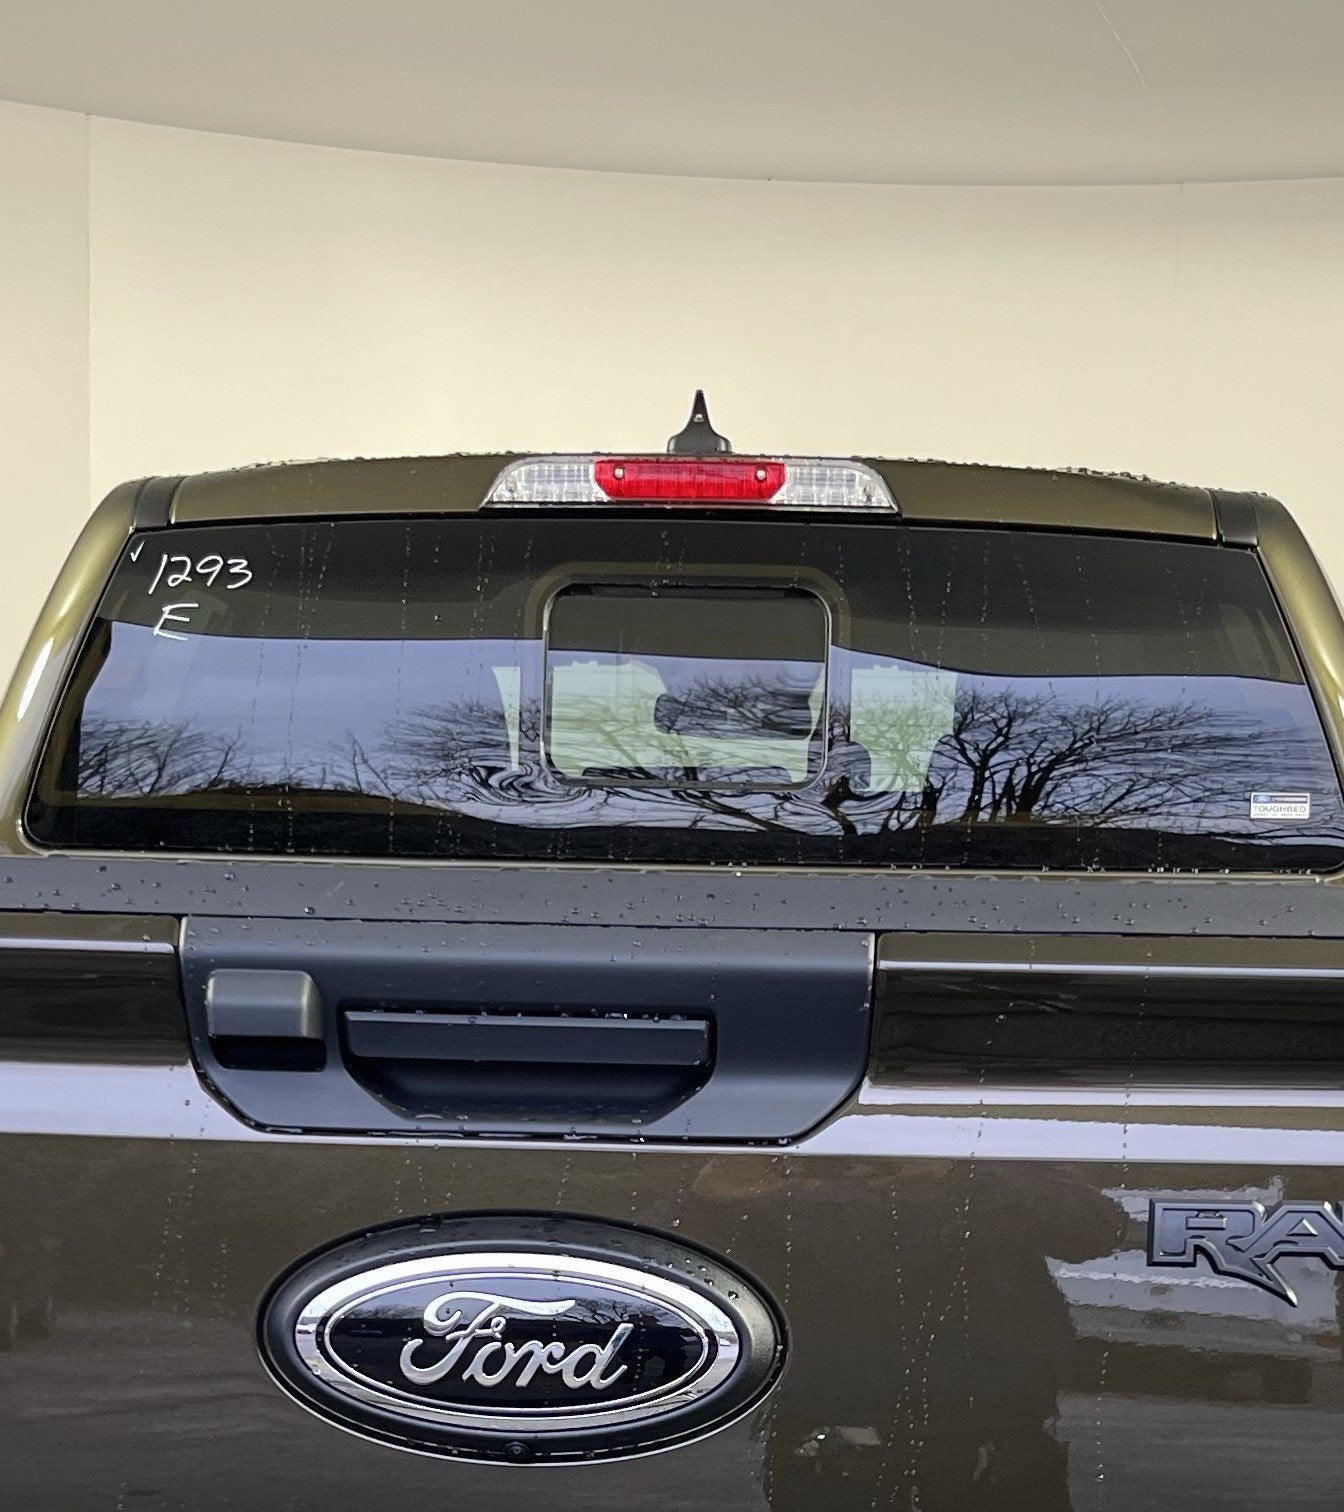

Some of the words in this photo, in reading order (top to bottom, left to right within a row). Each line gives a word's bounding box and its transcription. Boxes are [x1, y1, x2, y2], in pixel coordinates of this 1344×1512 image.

[147, 553, 253, 595] 1293
[153, 602, 199, 641] E
[398, 1290, 634, 1390] Ford
